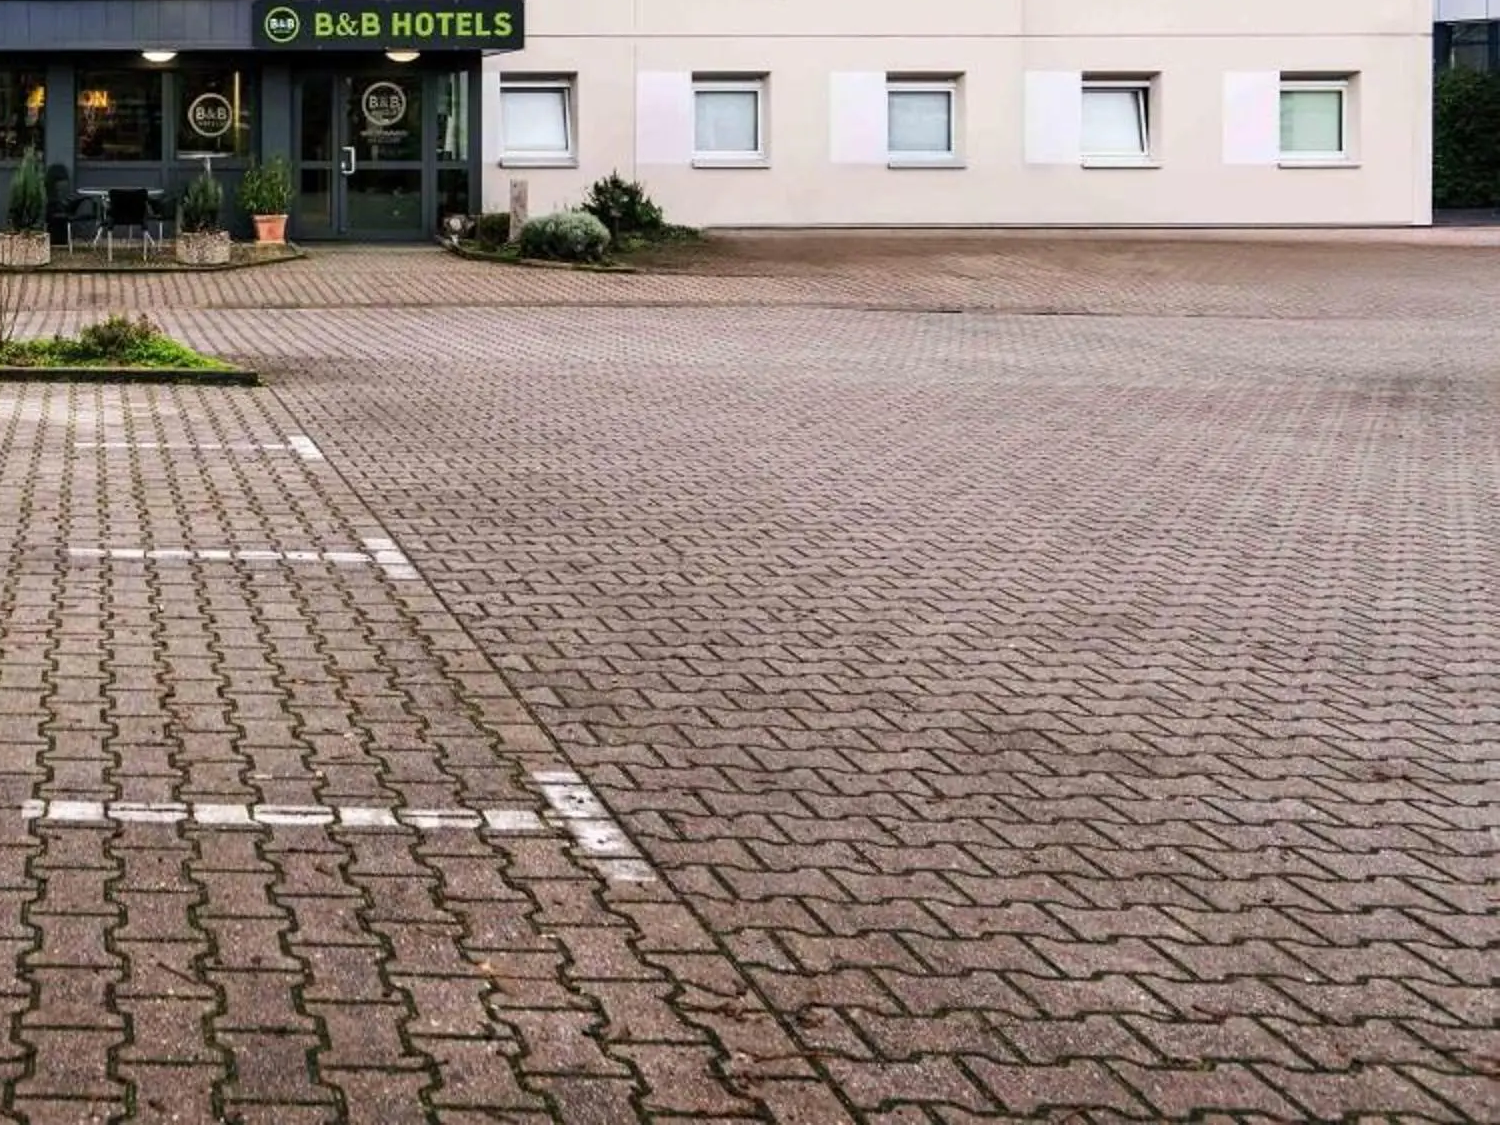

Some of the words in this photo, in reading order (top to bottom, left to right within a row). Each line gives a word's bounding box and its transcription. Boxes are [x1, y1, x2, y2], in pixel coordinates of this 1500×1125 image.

[314, 12, 381, 36] B&B
[391, 12, 513, 36] HOTELS
[195, 106, 227, 120] B&B
